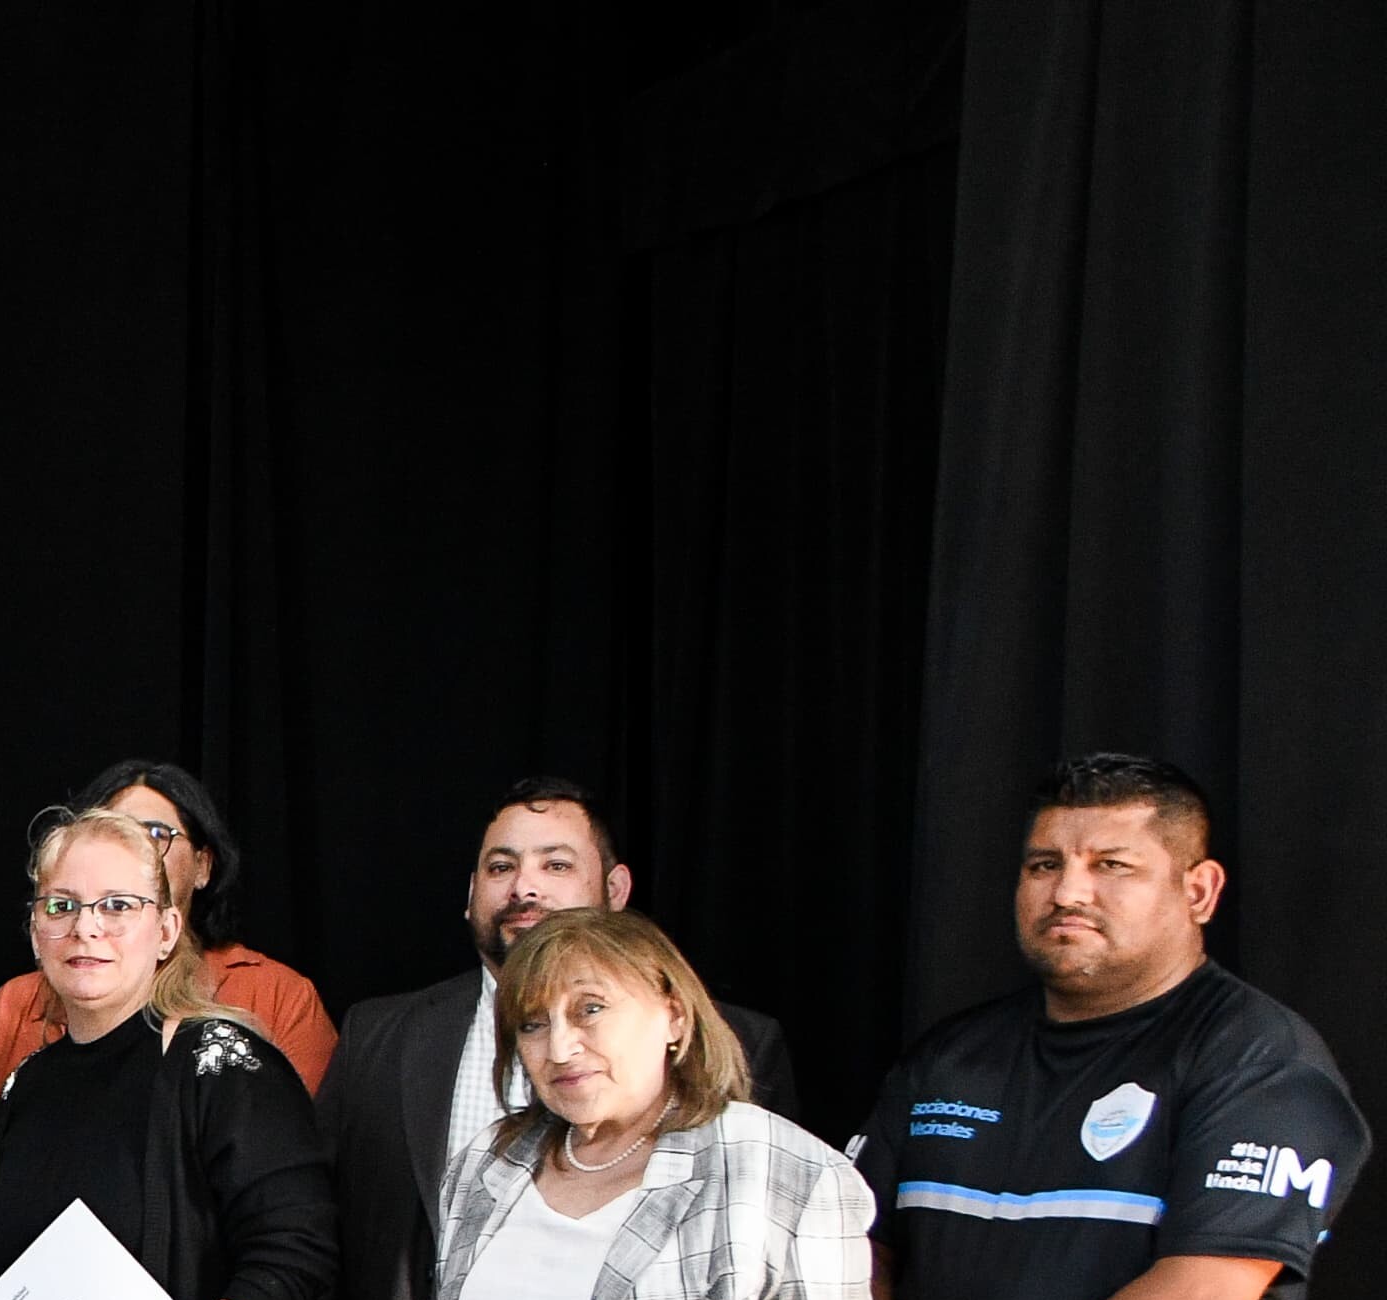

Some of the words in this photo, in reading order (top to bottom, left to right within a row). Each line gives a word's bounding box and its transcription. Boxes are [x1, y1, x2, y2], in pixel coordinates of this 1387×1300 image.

[910, 1098, 1002, 1124] sociaciones
[1230, 1142, 1269, 1160] #la
[1215, 1158, 1264, 1175] más
[1204, 1172, 1262, 1193] linda
[1269, 1146, 1333, 1209] M
